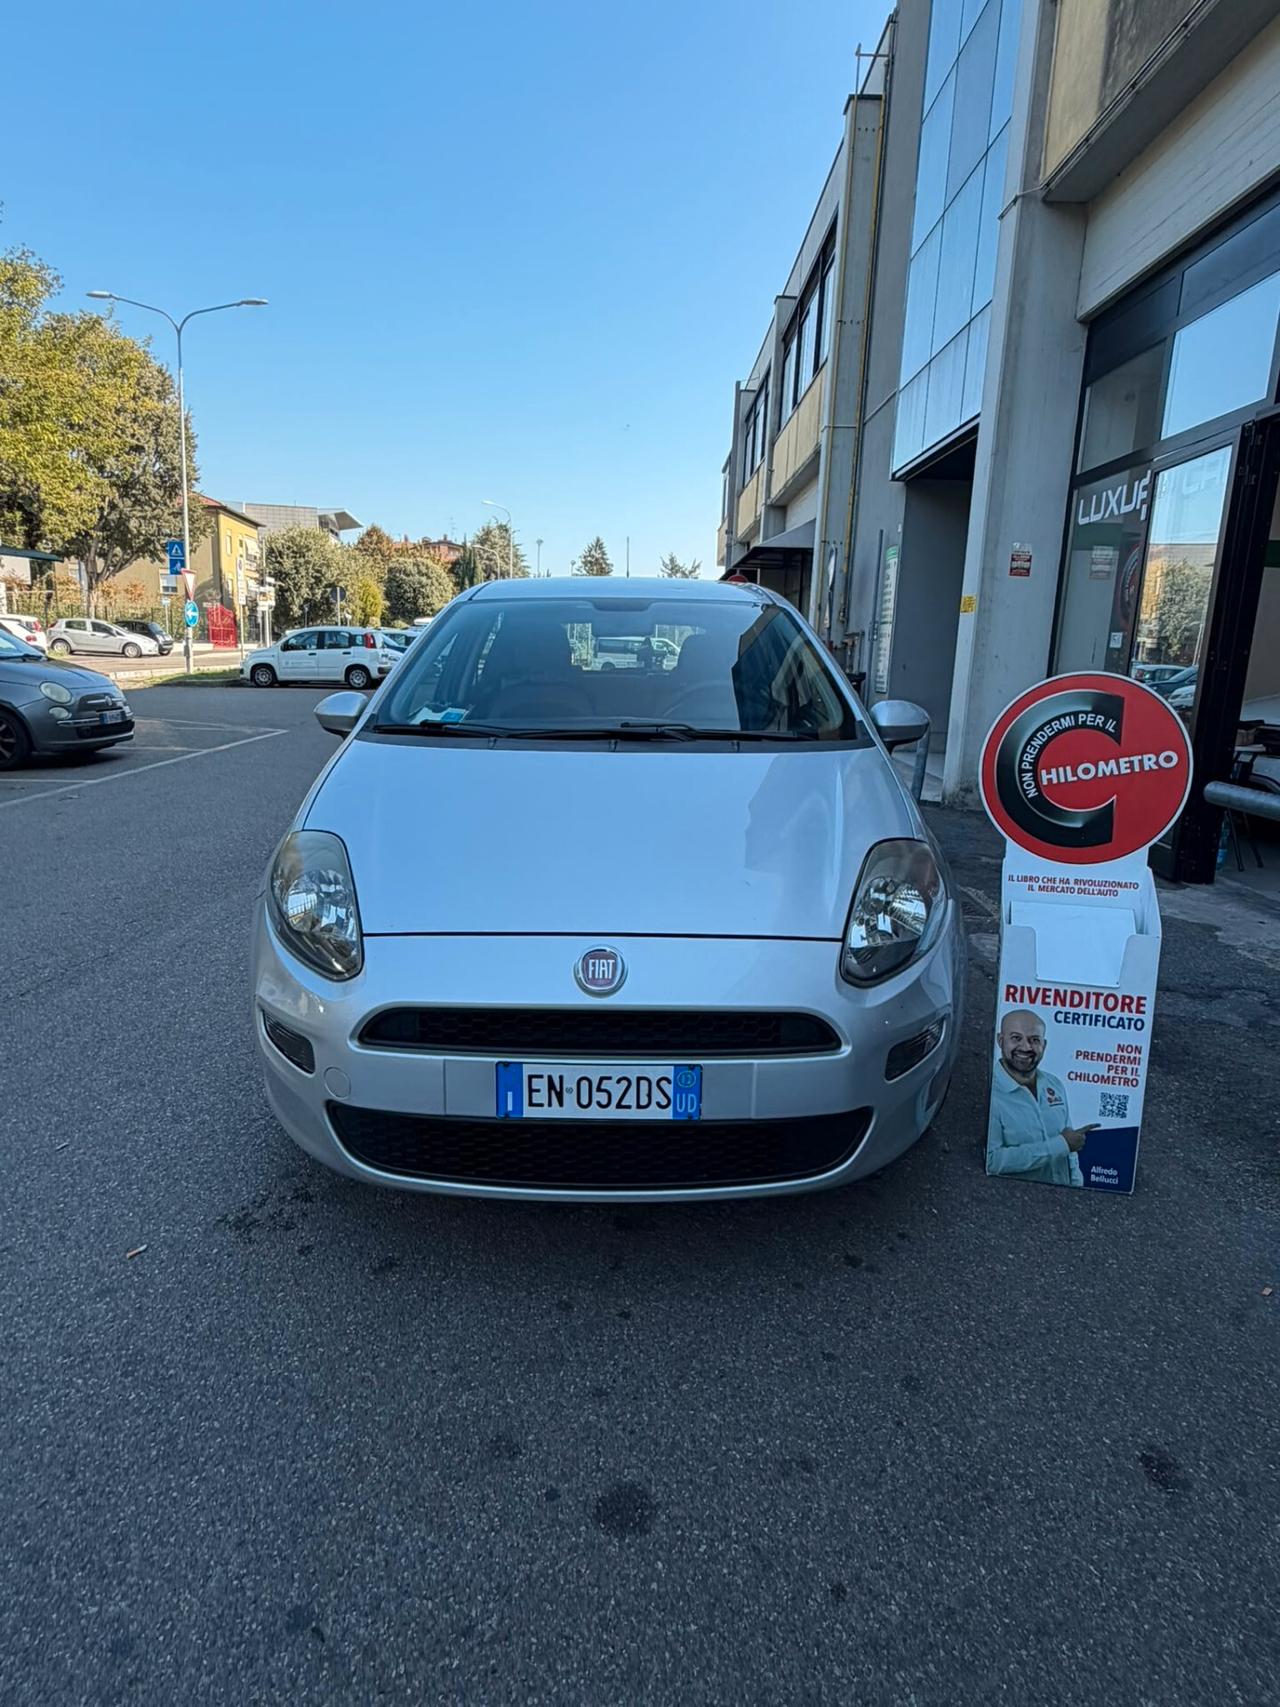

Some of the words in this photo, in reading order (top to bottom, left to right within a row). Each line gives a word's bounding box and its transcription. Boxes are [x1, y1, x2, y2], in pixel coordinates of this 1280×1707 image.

[1078, 713, 1103, 727] PER
[1105, 718, 1117, 733] IL
[1021, 715, 1075, 770] PRENDERMI
[1022, 772, 1039, 799] NON
[1008, 874, 1016, 882] IL
[1017, 874, 1040, 884] LIBRO
[1041, 876, 1057, 885] CHE
[1059, 877, 1071, 885] HA
[1073, 878, 1140, 890] RIVOLUZIONATO
[1027, 884, 1035, 892] IL
[1038, 885, 1076, 895] MERCATO
[1077, 886, 1119, 897] DELL'AUTO
[588, 959, 615, 979] FIAT
[1004, 984, 1148, 1015] RIVENDITORE
[1054, 1010, 1146, 1032] CERTIFICATO
[1116, 1043, 1142, 1055] NON
[1075, 1050, 1142, 1066] PRENDERMI
[1107, 1064, 1128, 1076] PER
[1130, 1067, 1140, 1077] IL
[1067, 1070, 1139, 1088] CHILOMETRO
[676, 1093, 697, 1113] UD
[1091, 1165, 1118, 1176] Alfredo
[1091, 1174, 1119, 1185] Bellucci
